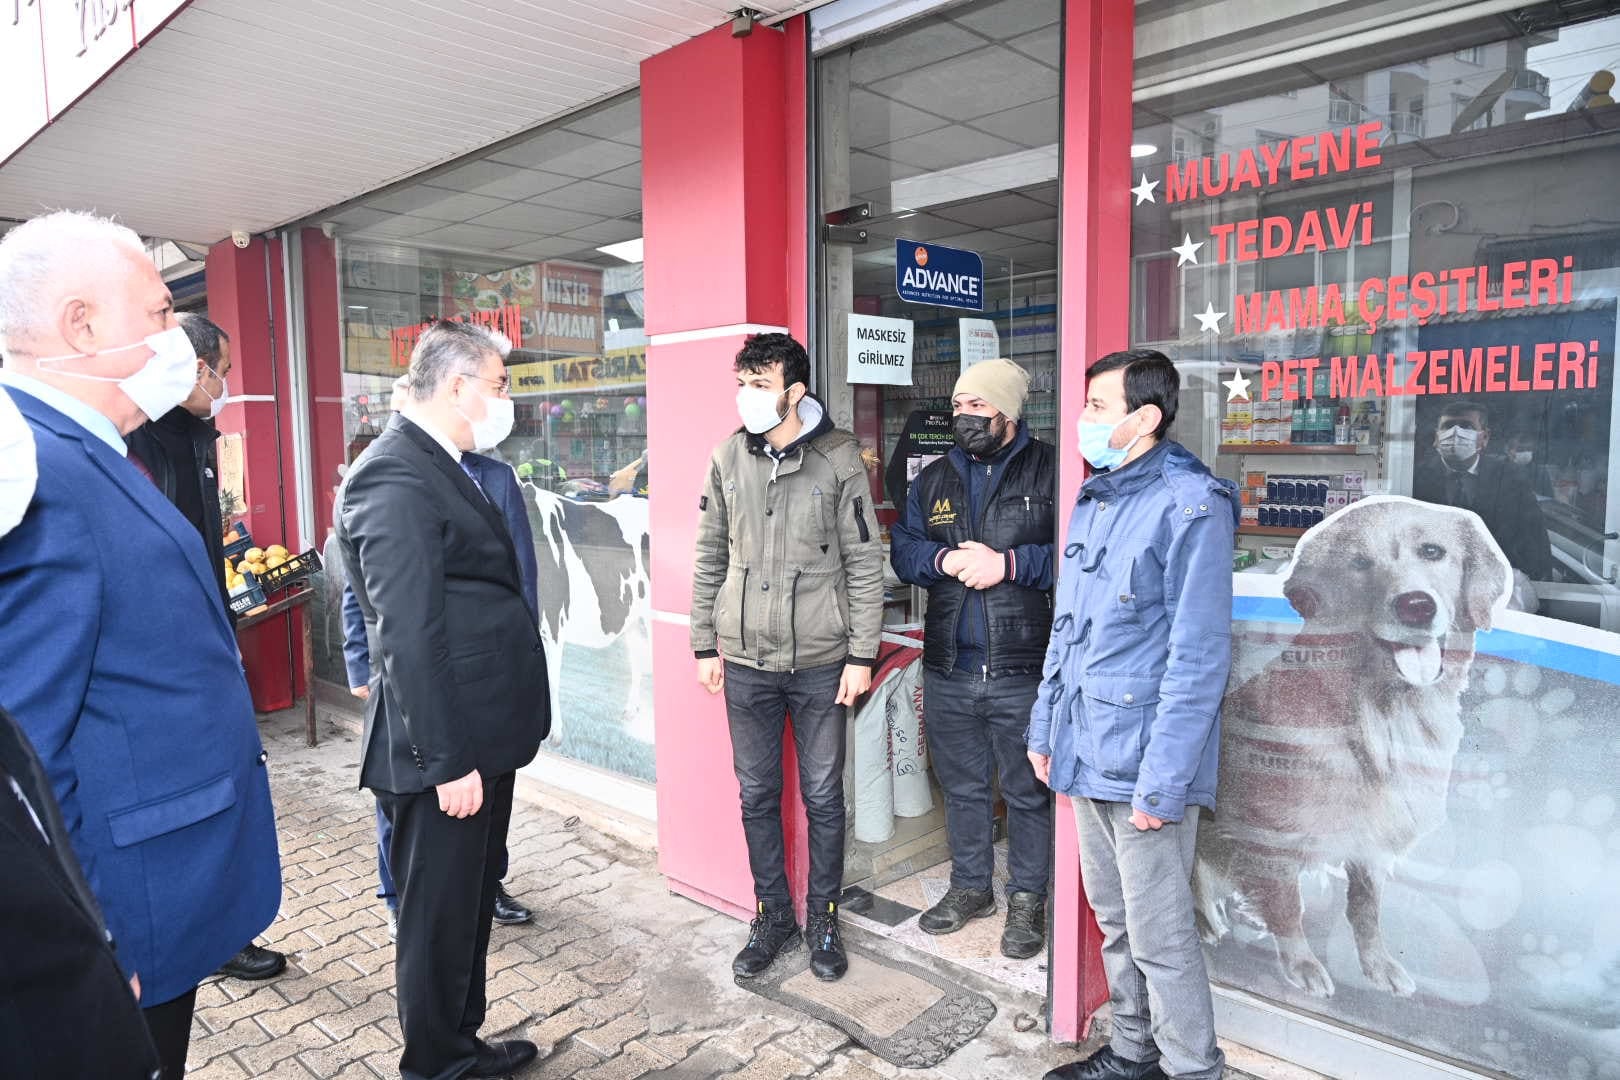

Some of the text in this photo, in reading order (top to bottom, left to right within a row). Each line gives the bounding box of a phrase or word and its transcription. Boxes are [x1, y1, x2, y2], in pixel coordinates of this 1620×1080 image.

[1166, 122, 1381, 203] MUAYENE
[900, 267, 977, 297] ADVANCE
[1235, 284, 1345, 334] MAMA
[857, 327, 906, 343] MASKESİZ
[858, 349, 905, 367] GİRİLMEZ
[1262, 359, 1321, 402] PET
